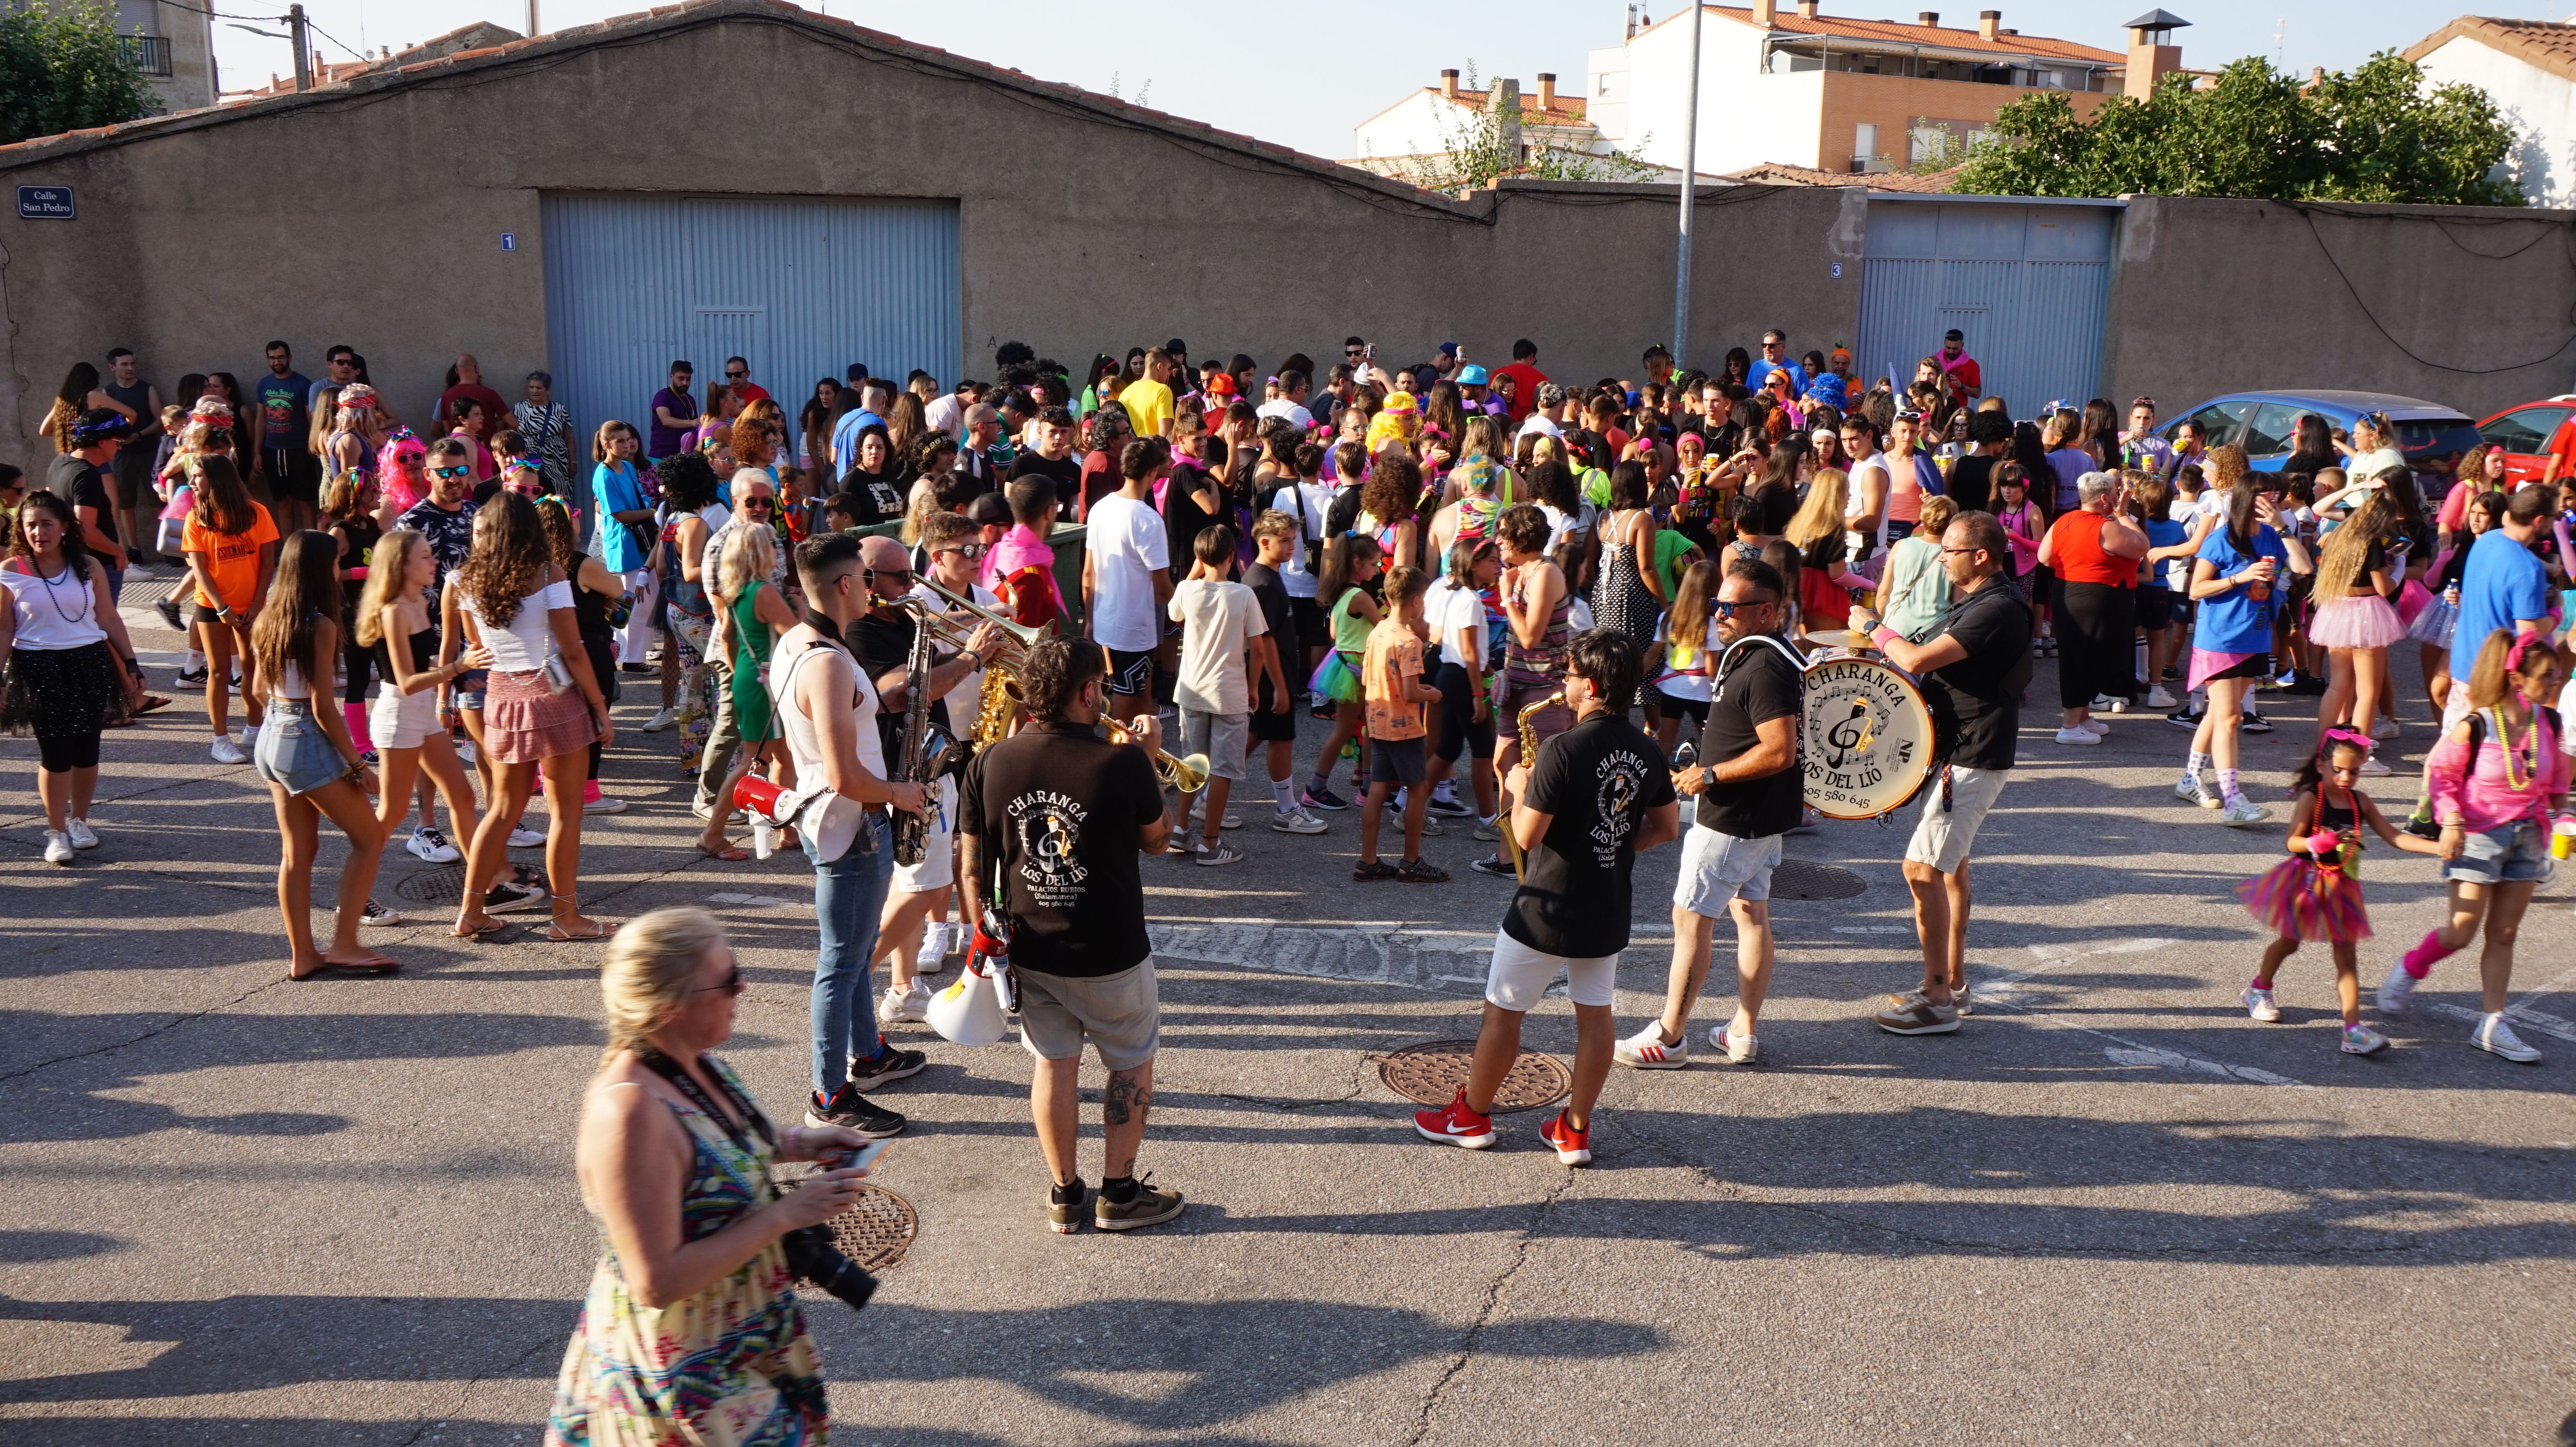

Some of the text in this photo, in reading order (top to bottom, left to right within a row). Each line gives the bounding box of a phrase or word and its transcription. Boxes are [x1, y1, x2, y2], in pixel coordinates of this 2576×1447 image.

[34, 191, 57, 199] Calle
[23, 203, 70, 212] San Pedro
[505, 236, 512, 248] 1
[1833, 265, 1840, 276] 3
[987, 335, 997, 348] A
[1687, 508, 1709, 517] GIRL
[1807, 664, 1907, 707] CHARANGA
[1898, 739, 1914, 763] NP
[1804, 755, 1823, 779] OS
[1825, 771, 1853, 789] DEL
[1858, 767, 1882, 788] LÍO
[1008, 790, 1088, 822] CHARANGA
[1824, 790, 1846, 801] 580
[1849, 794, 1870, 809] 645
[1590, 826, 1610, 843] LOS
[1615, 822, 1630, 837] LÍO
[1020, 864, 1088, 886] LOS DEL LÍO
[1027, 884, 1058, 893] PALACIOS
[1034, 892, 1077, 900] (Salamanca)
